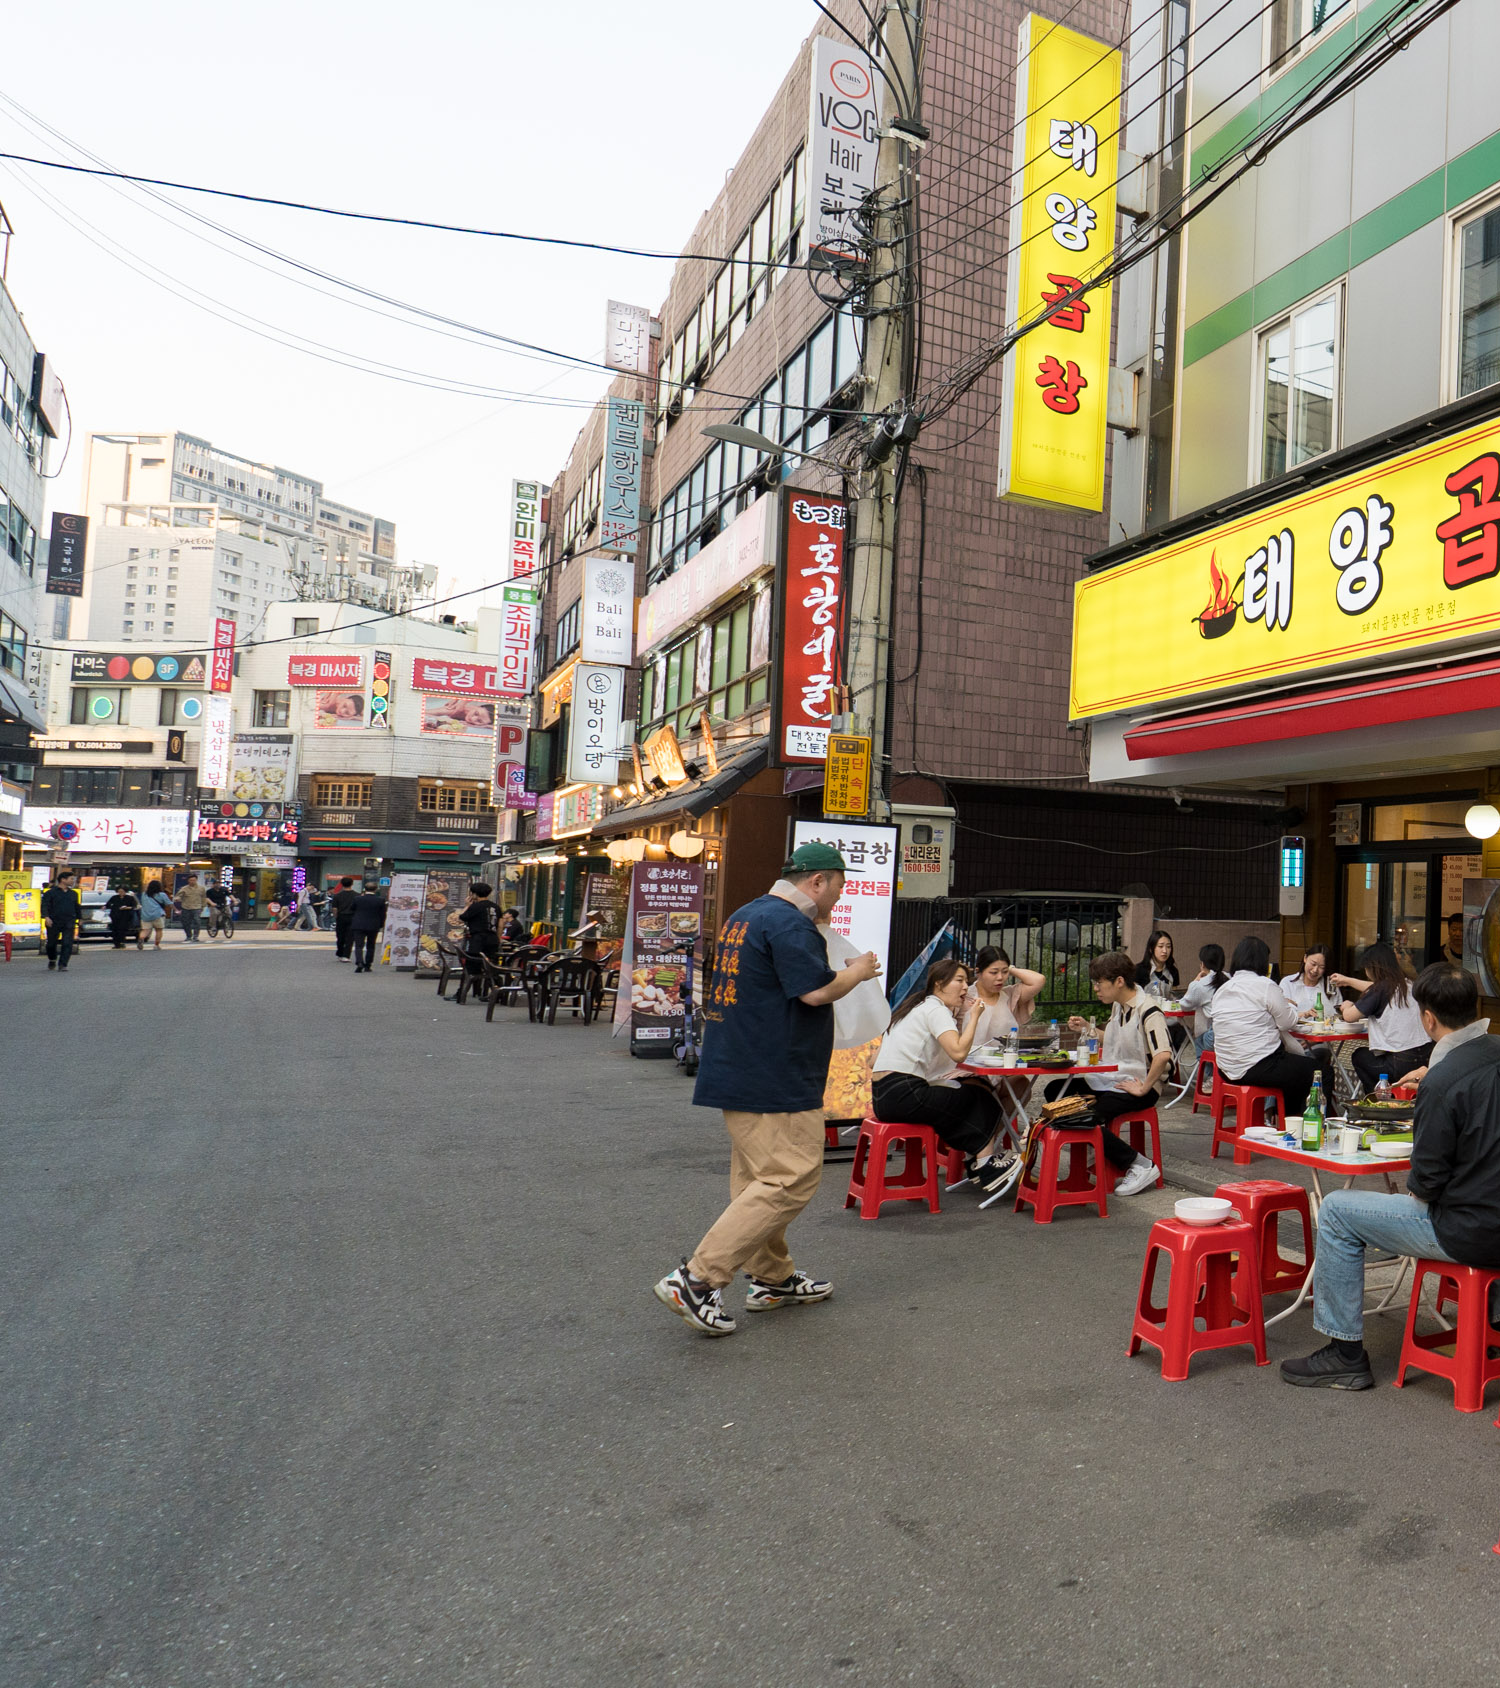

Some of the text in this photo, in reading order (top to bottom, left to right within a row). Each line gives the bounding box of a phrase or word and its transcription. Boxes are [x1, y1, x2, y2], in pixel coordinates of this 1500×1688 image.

[840, 72, 861, 85] PARIS
[829, 138, 862, 173] Hair
[1035, 118, 1098, 416] 태양곱창
[611, 541, 627, 549] 4F
[596, 602, 624, 616] Bali
[1361, 600, 1456, 634] 돼지곱창전골 전문점
[595, 626, 623, 640] Bali
[502, 604, 531, 690] 조개구이집
[74, 656, 175, 674] 나이스 3F
[291, 662, 359, 678] 북경 마사지
[422, 664, 475, 689] 북경
[586, 698, 607, 770] 방이오뎅
[791, 730, 826, 742] 대창전
[207, 719, 226, 786] 냉삼식당
[233, 746, 292, 758] 오뎅끼데스까
[848, 757, 865, 810] 단속중
[800, 837, 893, 865] 양곱창
[910, 846, 941, 860] 대리운전
[640, 883, 698, 894] 정통 일식 덮밥
[840, 880, 891, 897] 창전골
[831, 904, 852, 914] 00원
[831, 915, 852, 925] 00원
[636, 954, 654, 963] 한우
